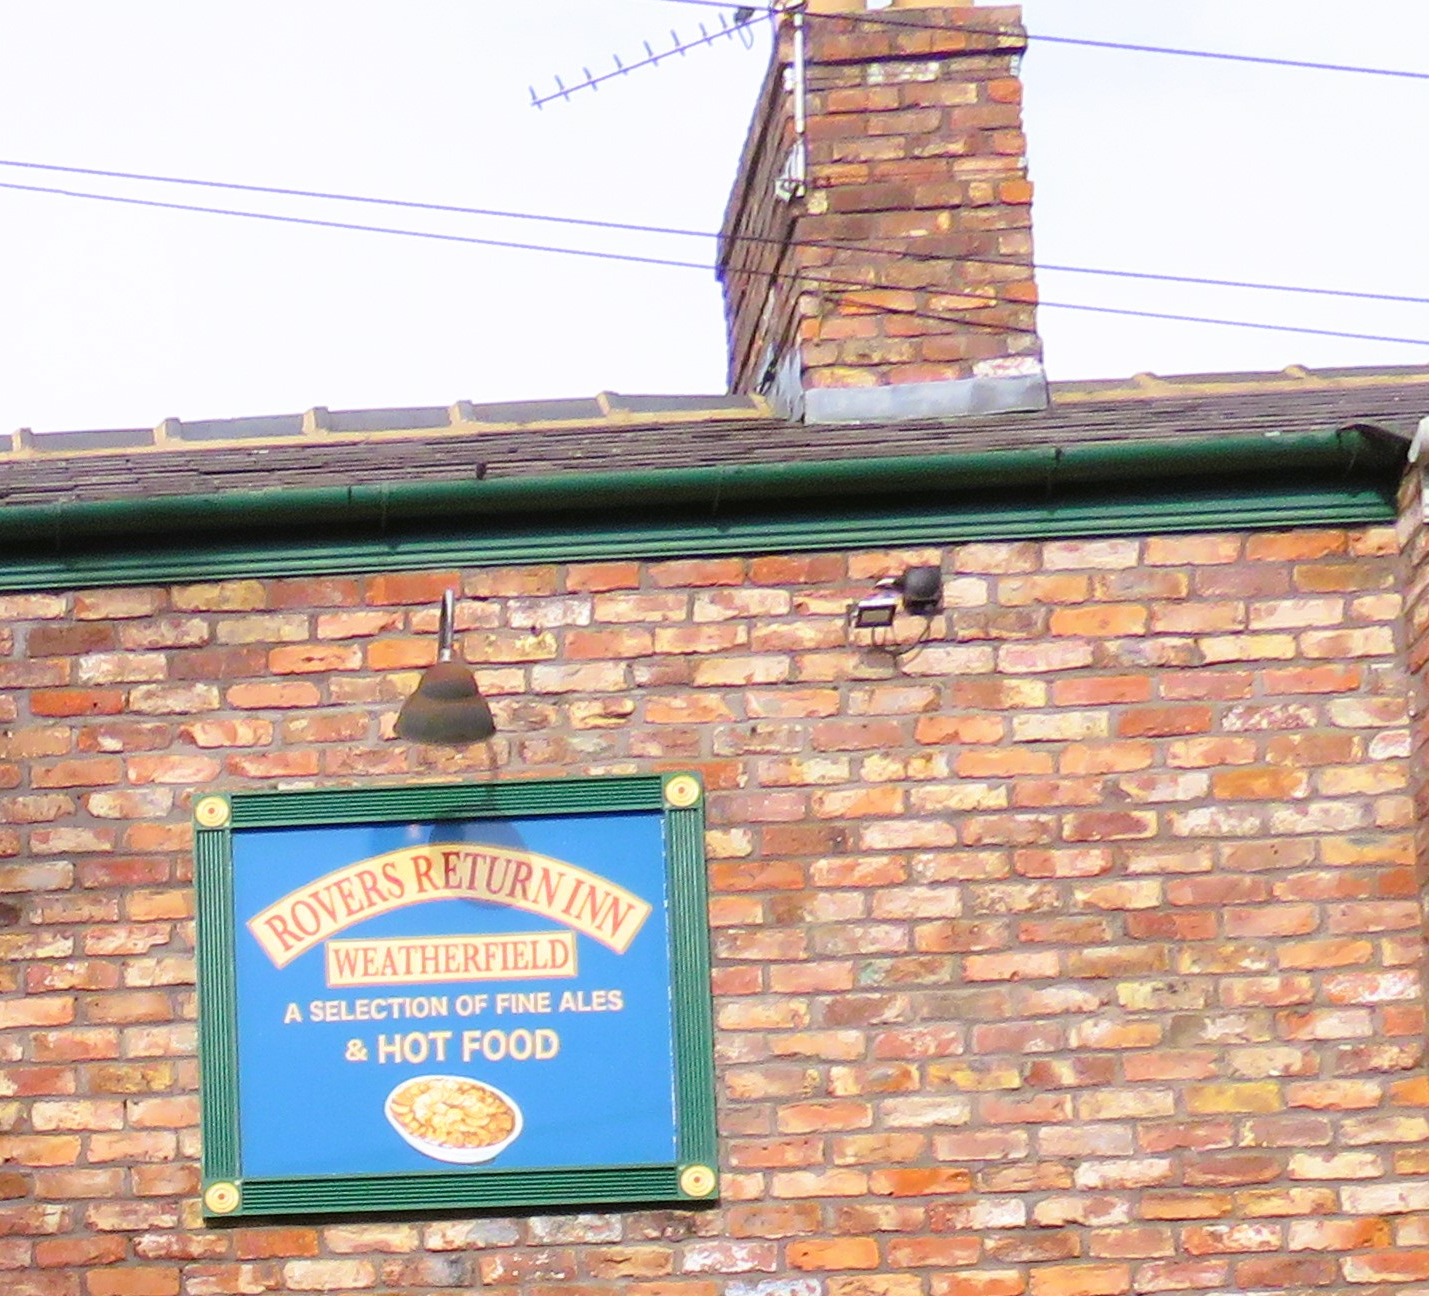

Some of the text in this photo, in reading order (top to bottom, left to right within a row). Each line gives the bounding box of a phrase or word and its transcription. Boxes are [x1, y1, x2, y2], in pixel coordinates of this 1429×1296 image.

[264, 851, 637, 952] ROVERS RETURN INN
[332, 943, 569, 979] WEATHERFIELD
[282, 989, 624, 1023] A SELECTION OF FINE ALES
[345, 1029, 560, 1064] & HOT FOOD
